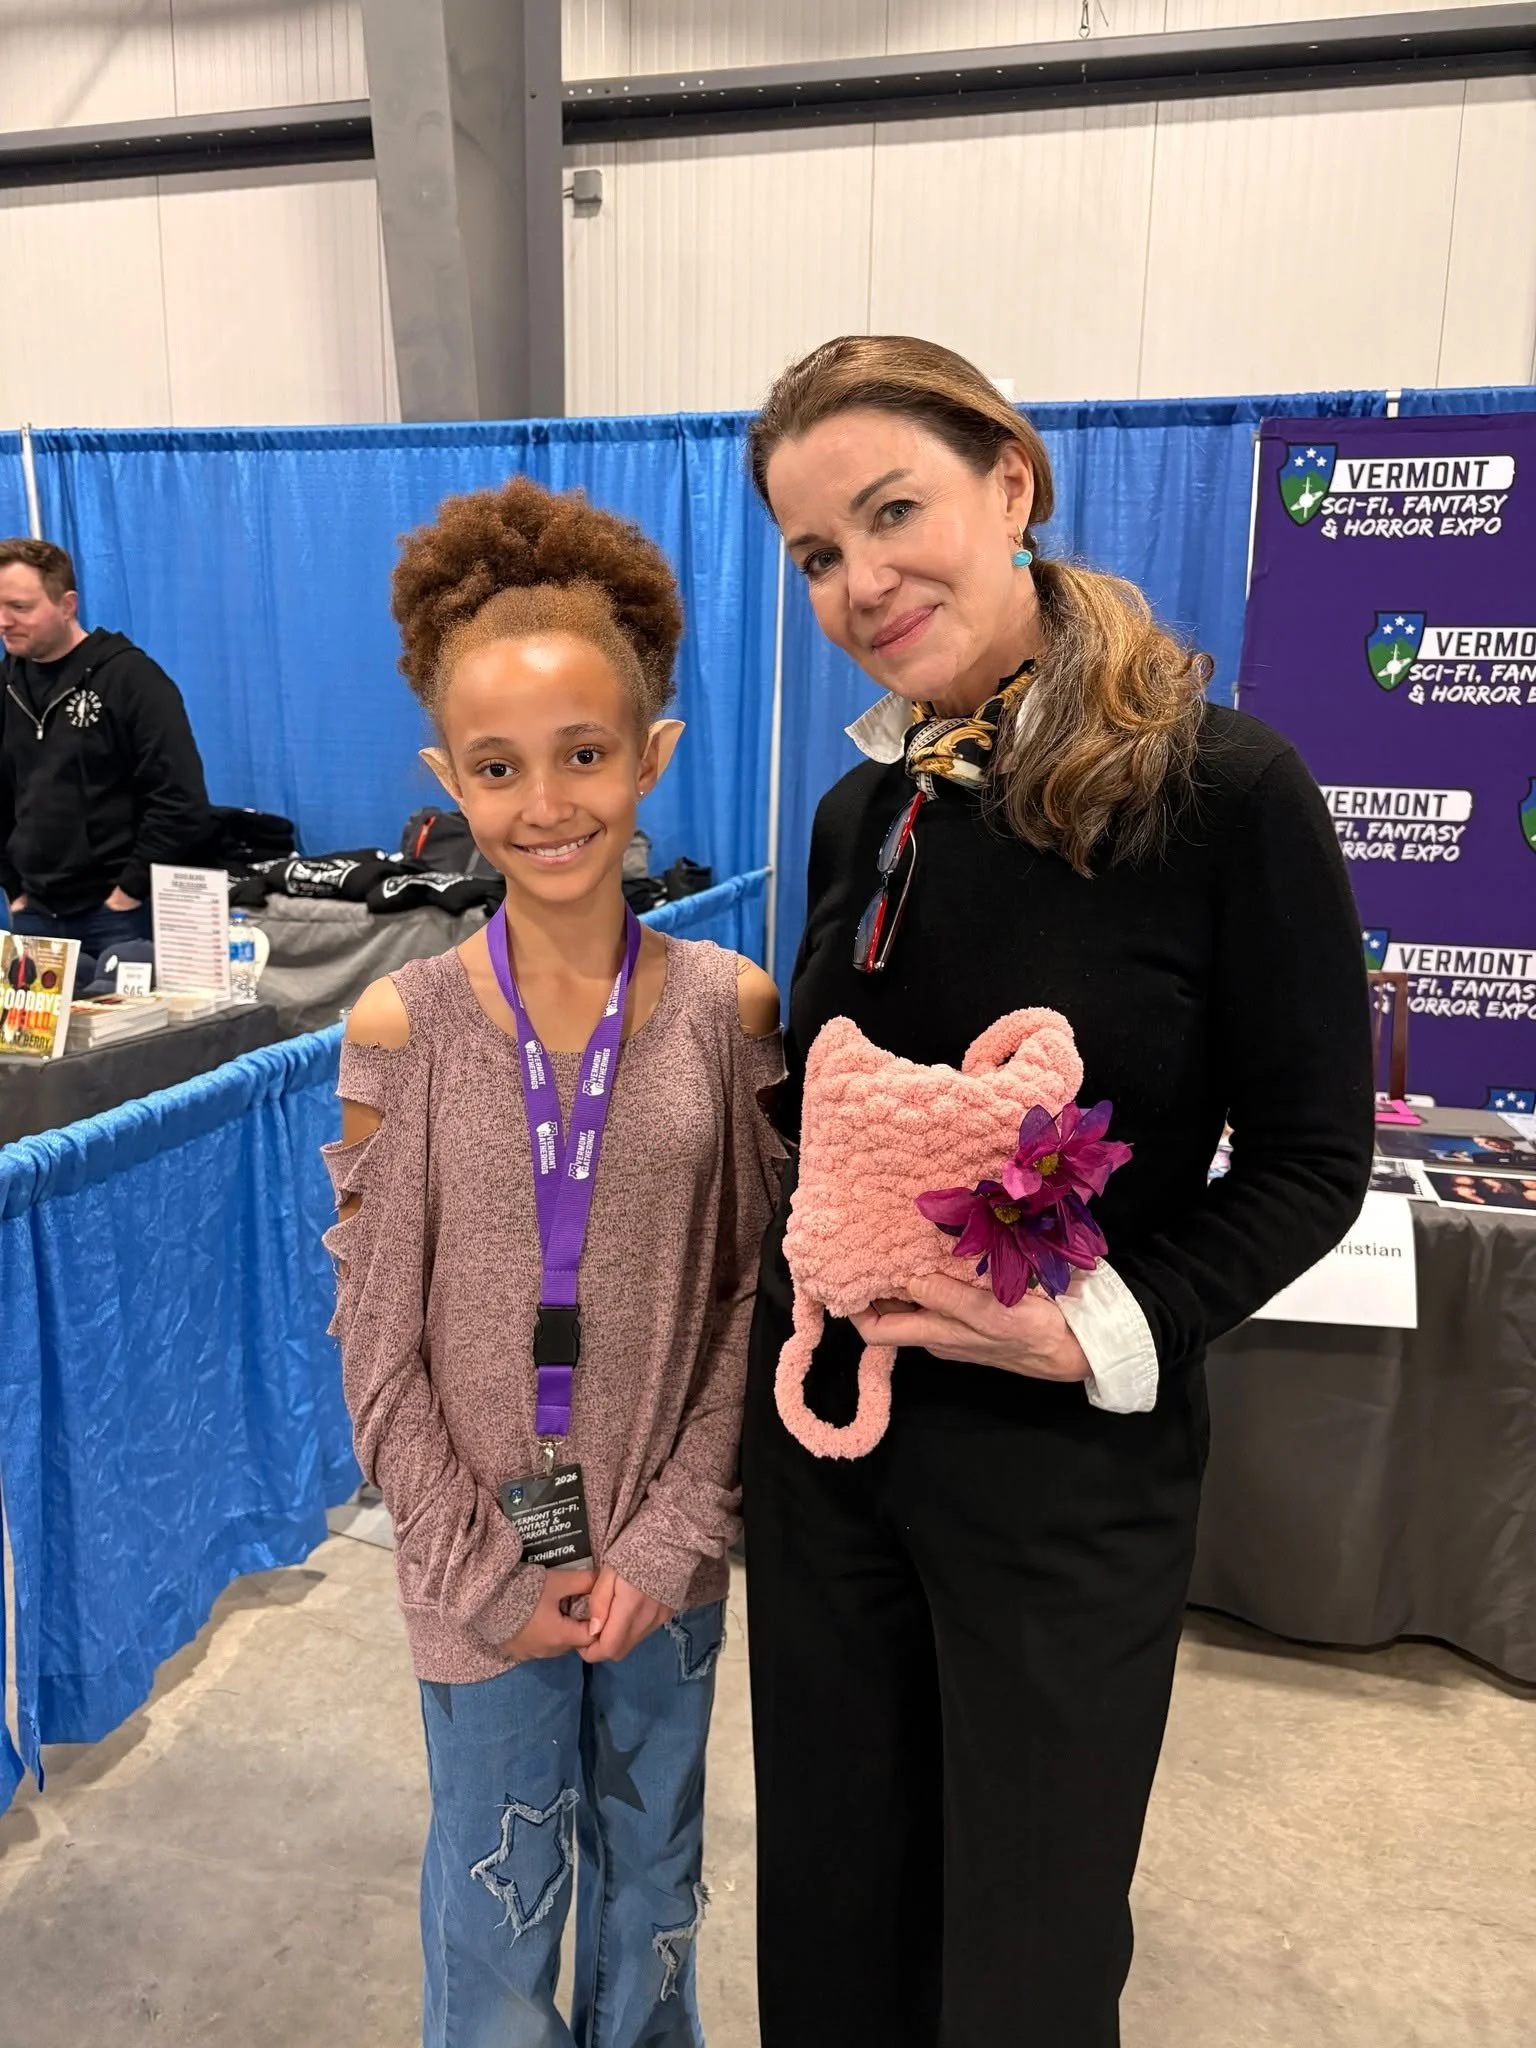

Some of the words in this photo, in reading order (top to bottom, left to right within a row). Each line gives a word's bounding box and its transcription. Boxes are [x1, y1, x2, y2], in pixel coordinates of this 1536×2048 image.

[1347, 460, 1490, 490] VERMONT
[1402, 494, 1509, 515] FANTASY
[1320, 520, 1338, 539] &
[1343, 518, 1434, 539] HORROR
[1439, 517, 1502, 536] EXPO
[1436, 631, 1536, 657] VERMO
[1408, 686, 1425, 705] &
[1430, 685, 1522, 706] HORROR
[1367, 822, 1466, 844] FANTASY
[1342, 840, 1397, 862] RROR
[1401, 844, 1461, 862] EXPO
[1399, 947, 1533, 976] VERMONT
[1450, 980, 1536, 1002] FANTAS
[8, 1008, 51, 1030] HELLO
[1407, 996, 1481, 1020] ORROR
[525, 1048, 539, 1090] GATHERINGS
[534, 1053, 546, 1086] VERMONT
[589, 1050, 603, 1084] VERMONT
[596, 1048, 611, 1090] GATHERINGS
[537, 1130, 549, 1175] GATHERINGS
[547, 1133, 556, 1170] VERMONT
[575, 1131, 587, 1167] VERMONT
[581, 1129, 596, 1173] GATHERINGS
[1335, 1241, 1402, 1257] ristian
[555, 1473, 578, 1486] 2026
[512, 1511, 550, 1526] VERMONT
[519, 1519, 550, 1533] ANTASY
[553, 1517, 560, 1525] &
[521, 1529, 548, 1541] ORROR
[549, 1521, 571, 1533] EXPO
[528, 1545, 576, 1562] EXHIBITOR
